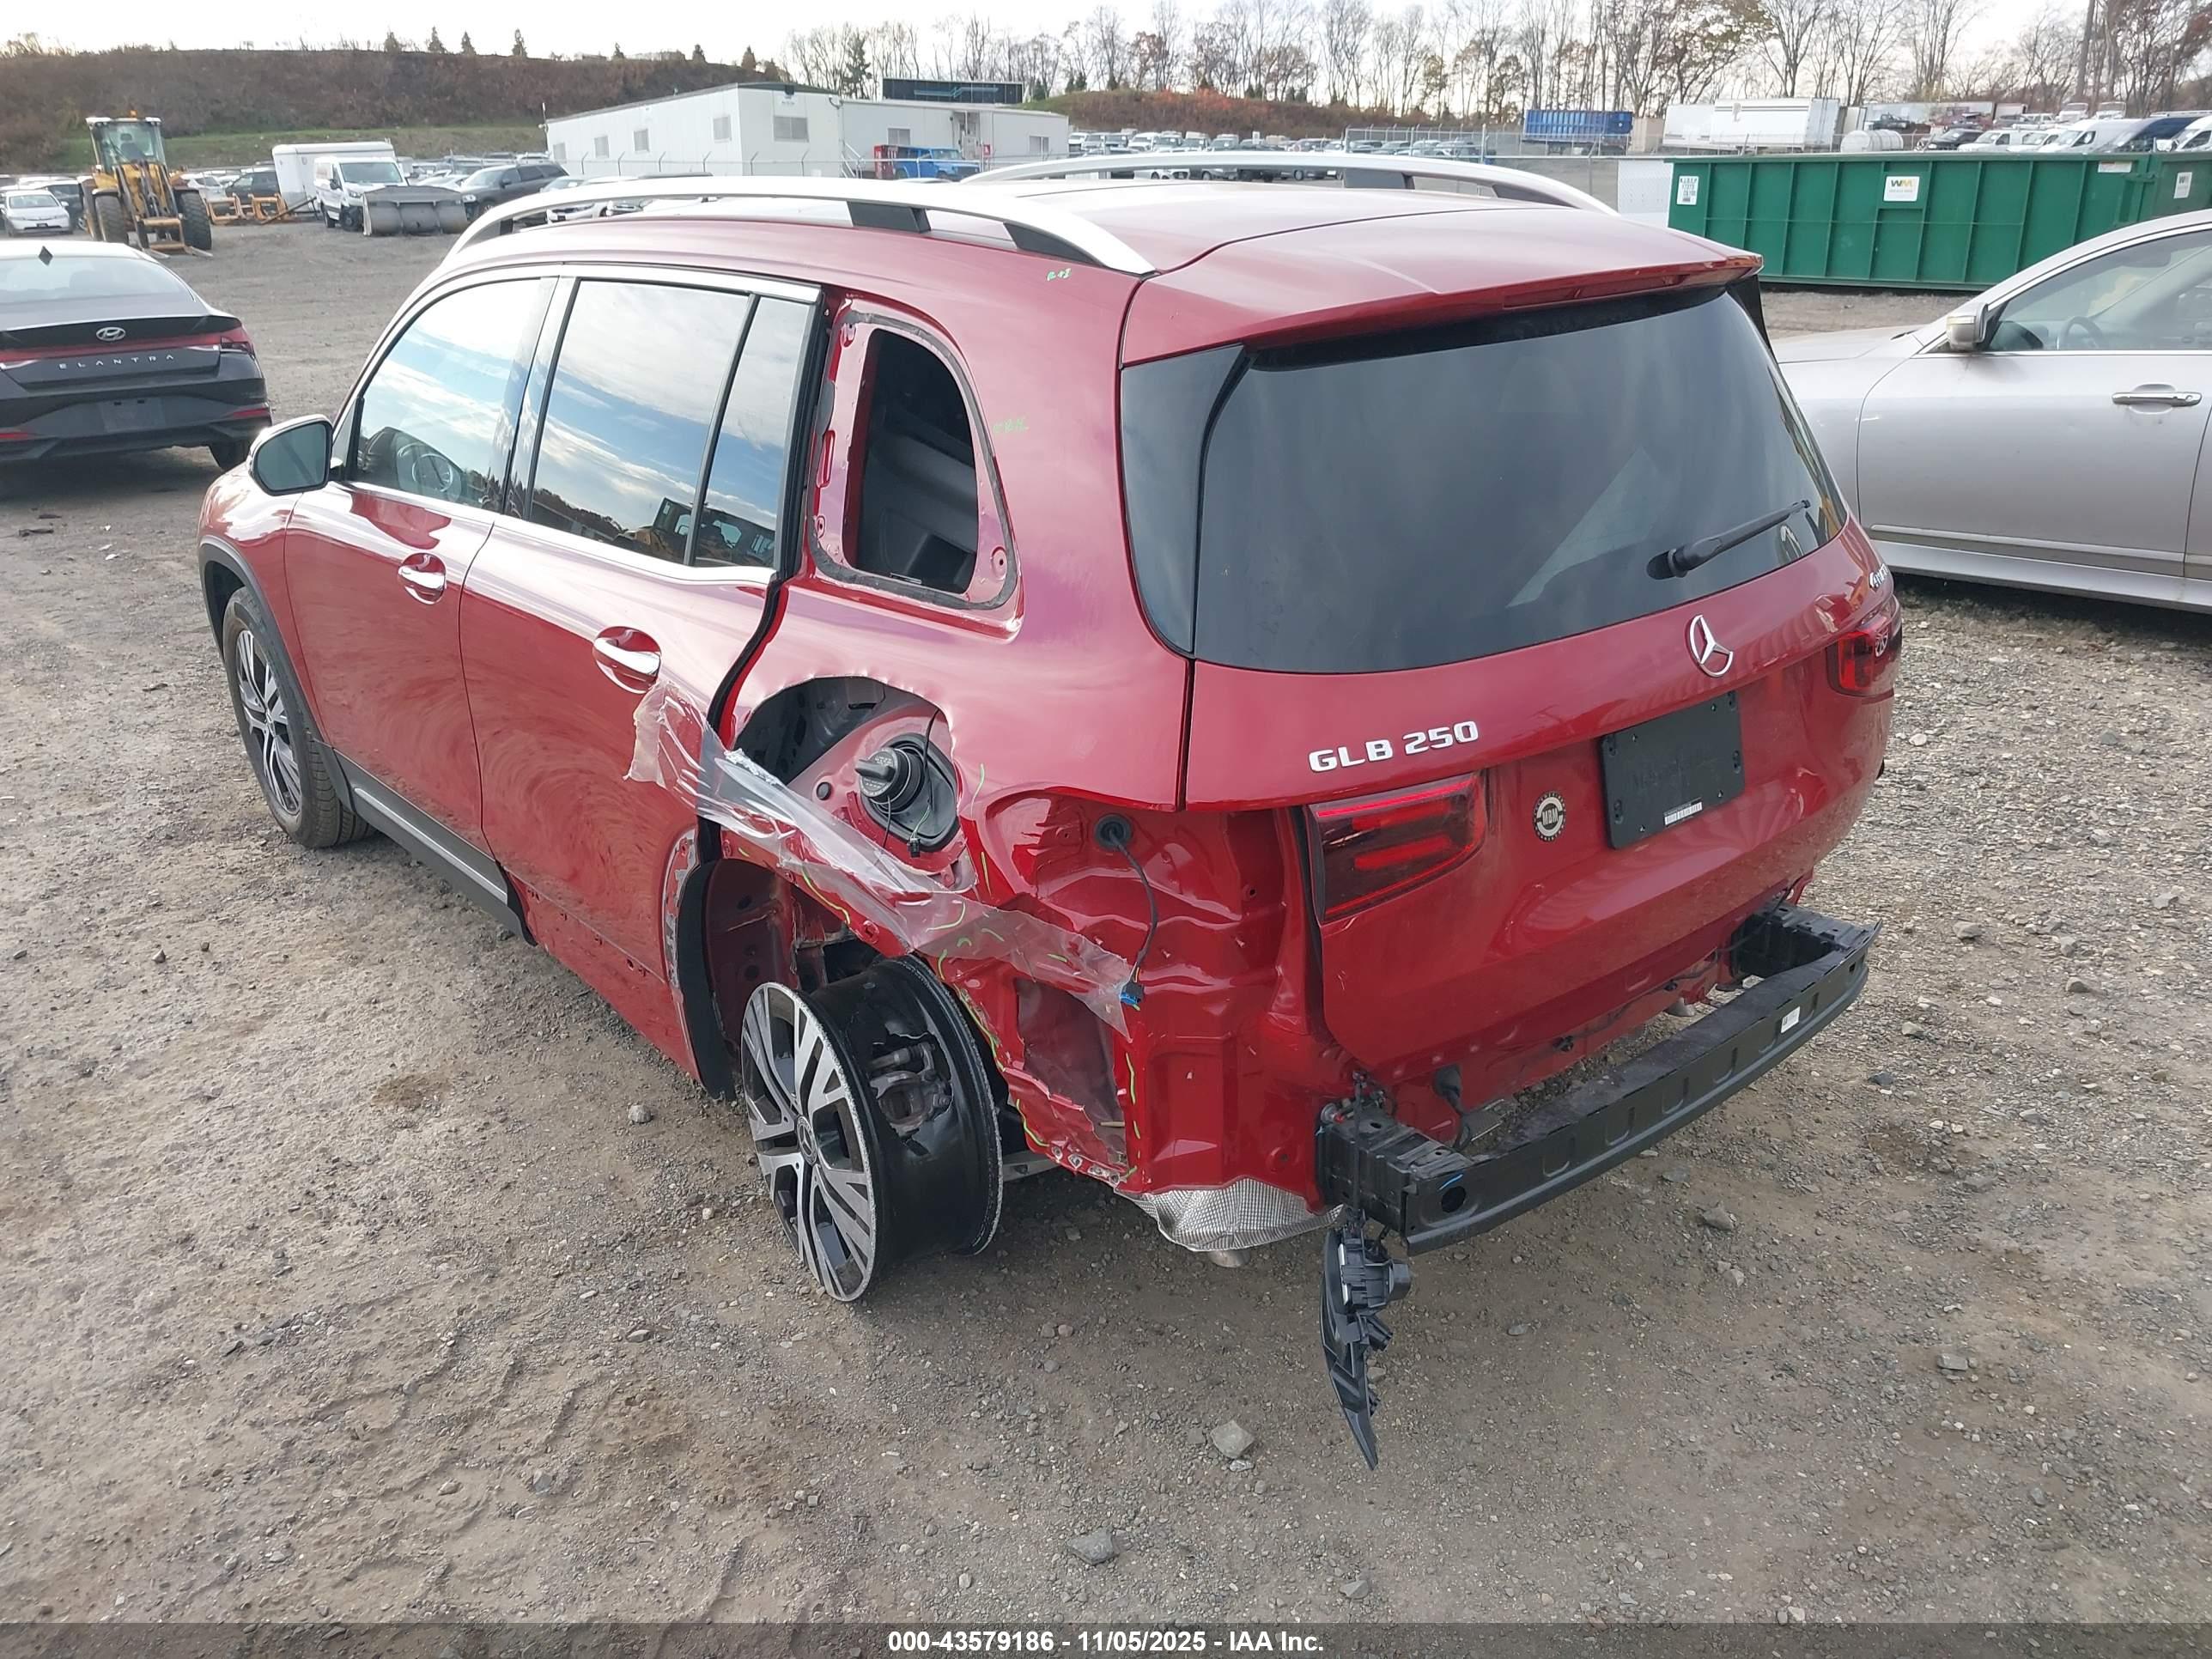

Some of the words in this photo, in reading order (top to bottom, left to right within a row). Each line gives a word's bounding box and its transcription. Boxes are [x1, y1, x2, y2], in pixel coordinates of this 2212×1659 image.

[58, 354, 174, 369] ELANTRA
[1309, 739, 1394, 772] GLB
[1402, 720, 1479, 756] 250
